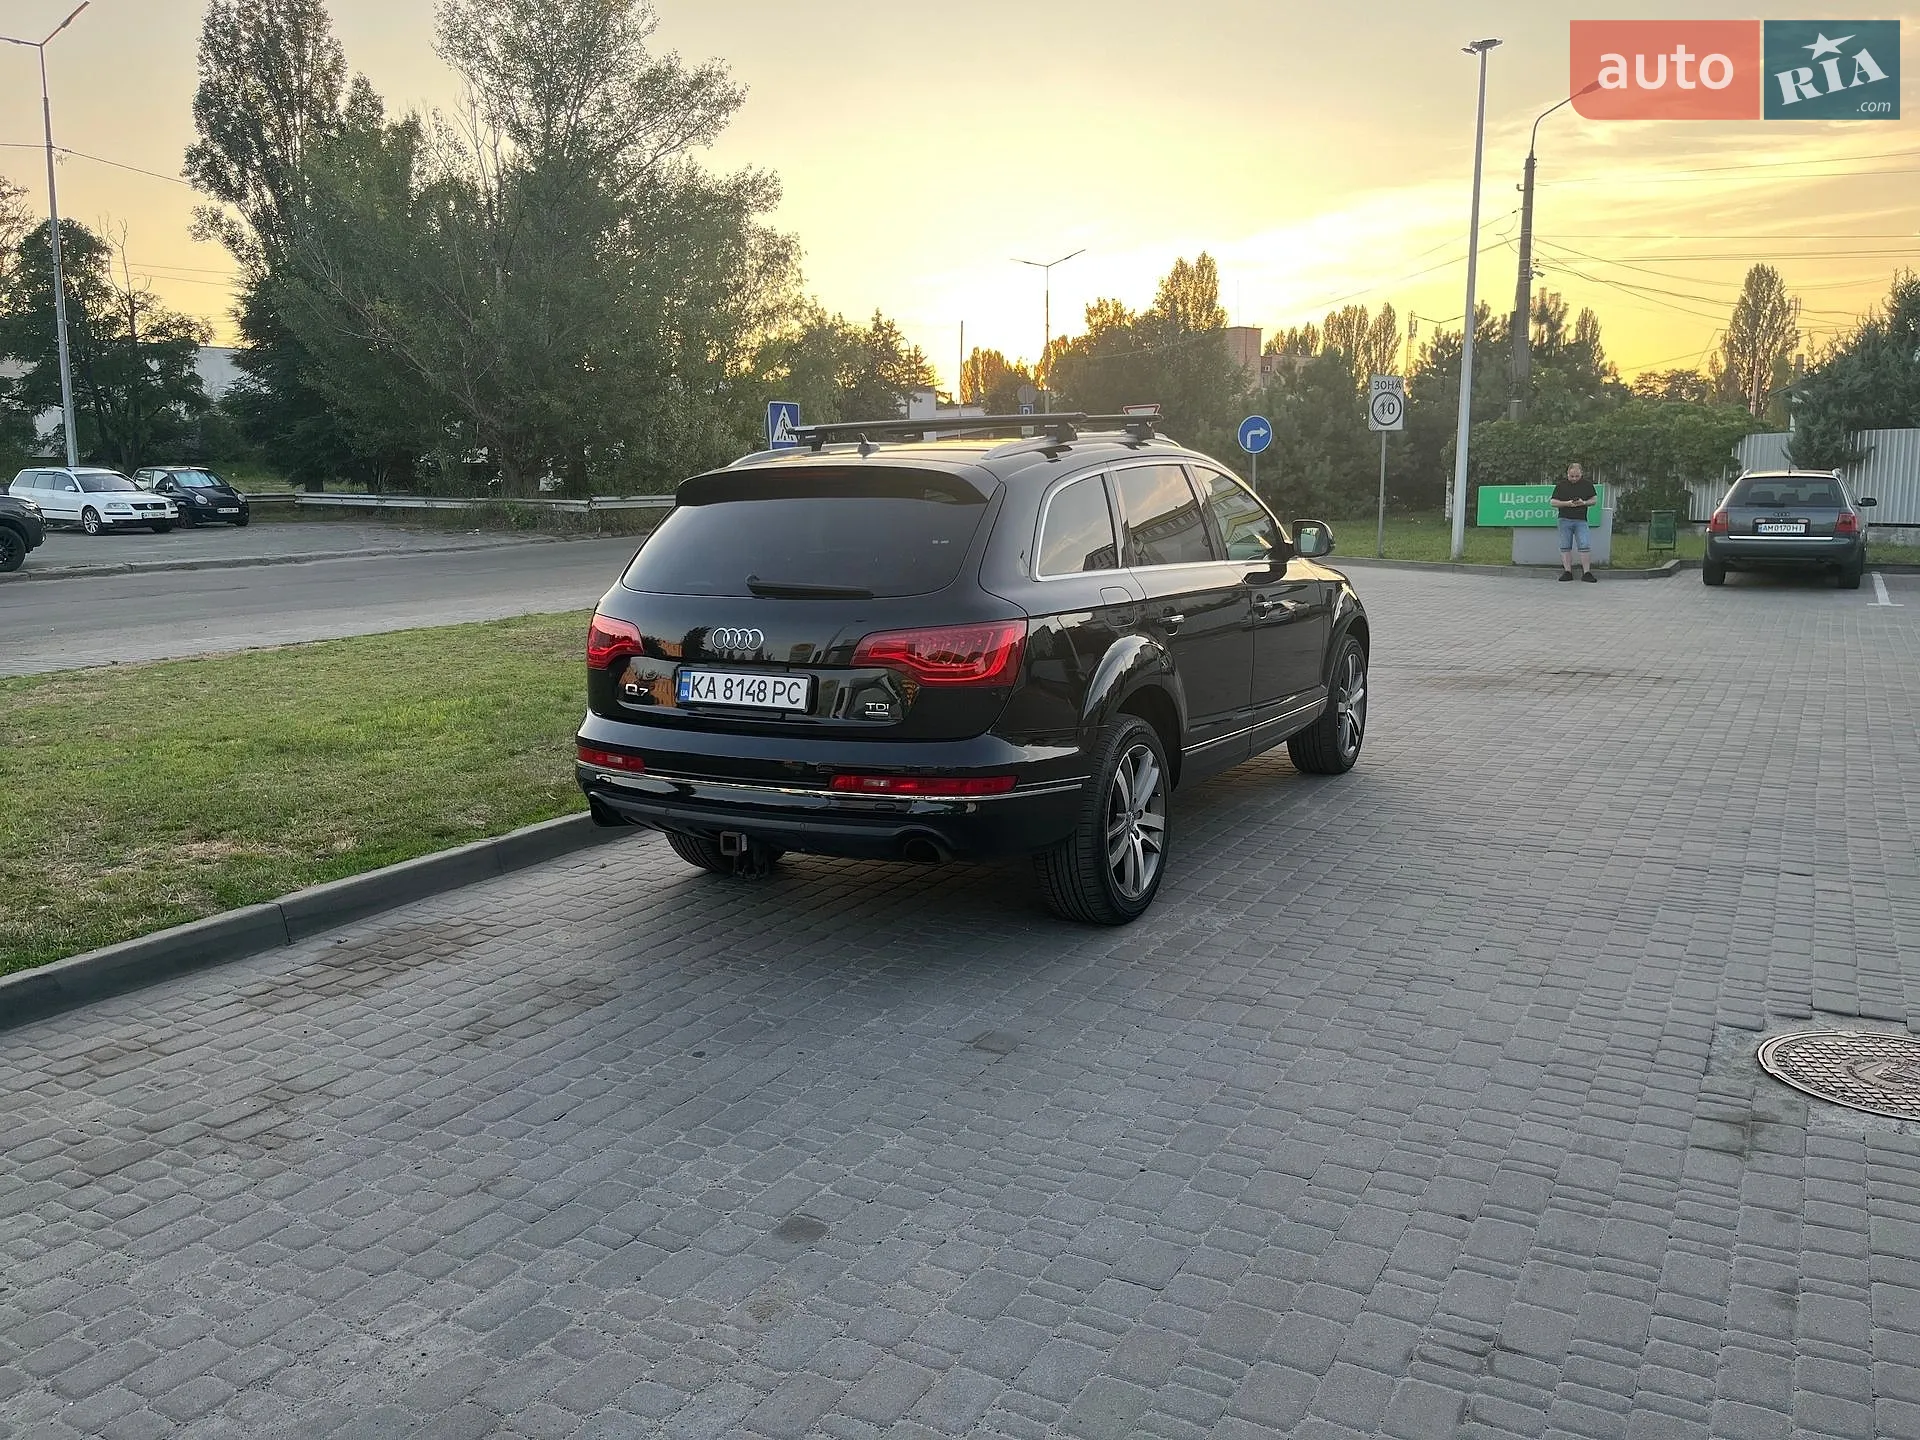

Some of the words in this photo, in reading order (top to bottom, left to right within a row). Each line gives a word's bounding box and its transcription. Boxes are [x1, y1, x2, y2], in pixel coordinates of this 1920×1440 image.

[1374, 380, 1402, 390] ЗОНА
[1499, 492, 1552, 505] Щасли
[625, 683, 649, 697] Q7
[680, 689, 689, 697] UA
[691, 675, 717, 700] KA
[723, 677, 767, 703] 8148
[772, 680, 801, 705] PC
[865, 702, 890, 711] TDI
